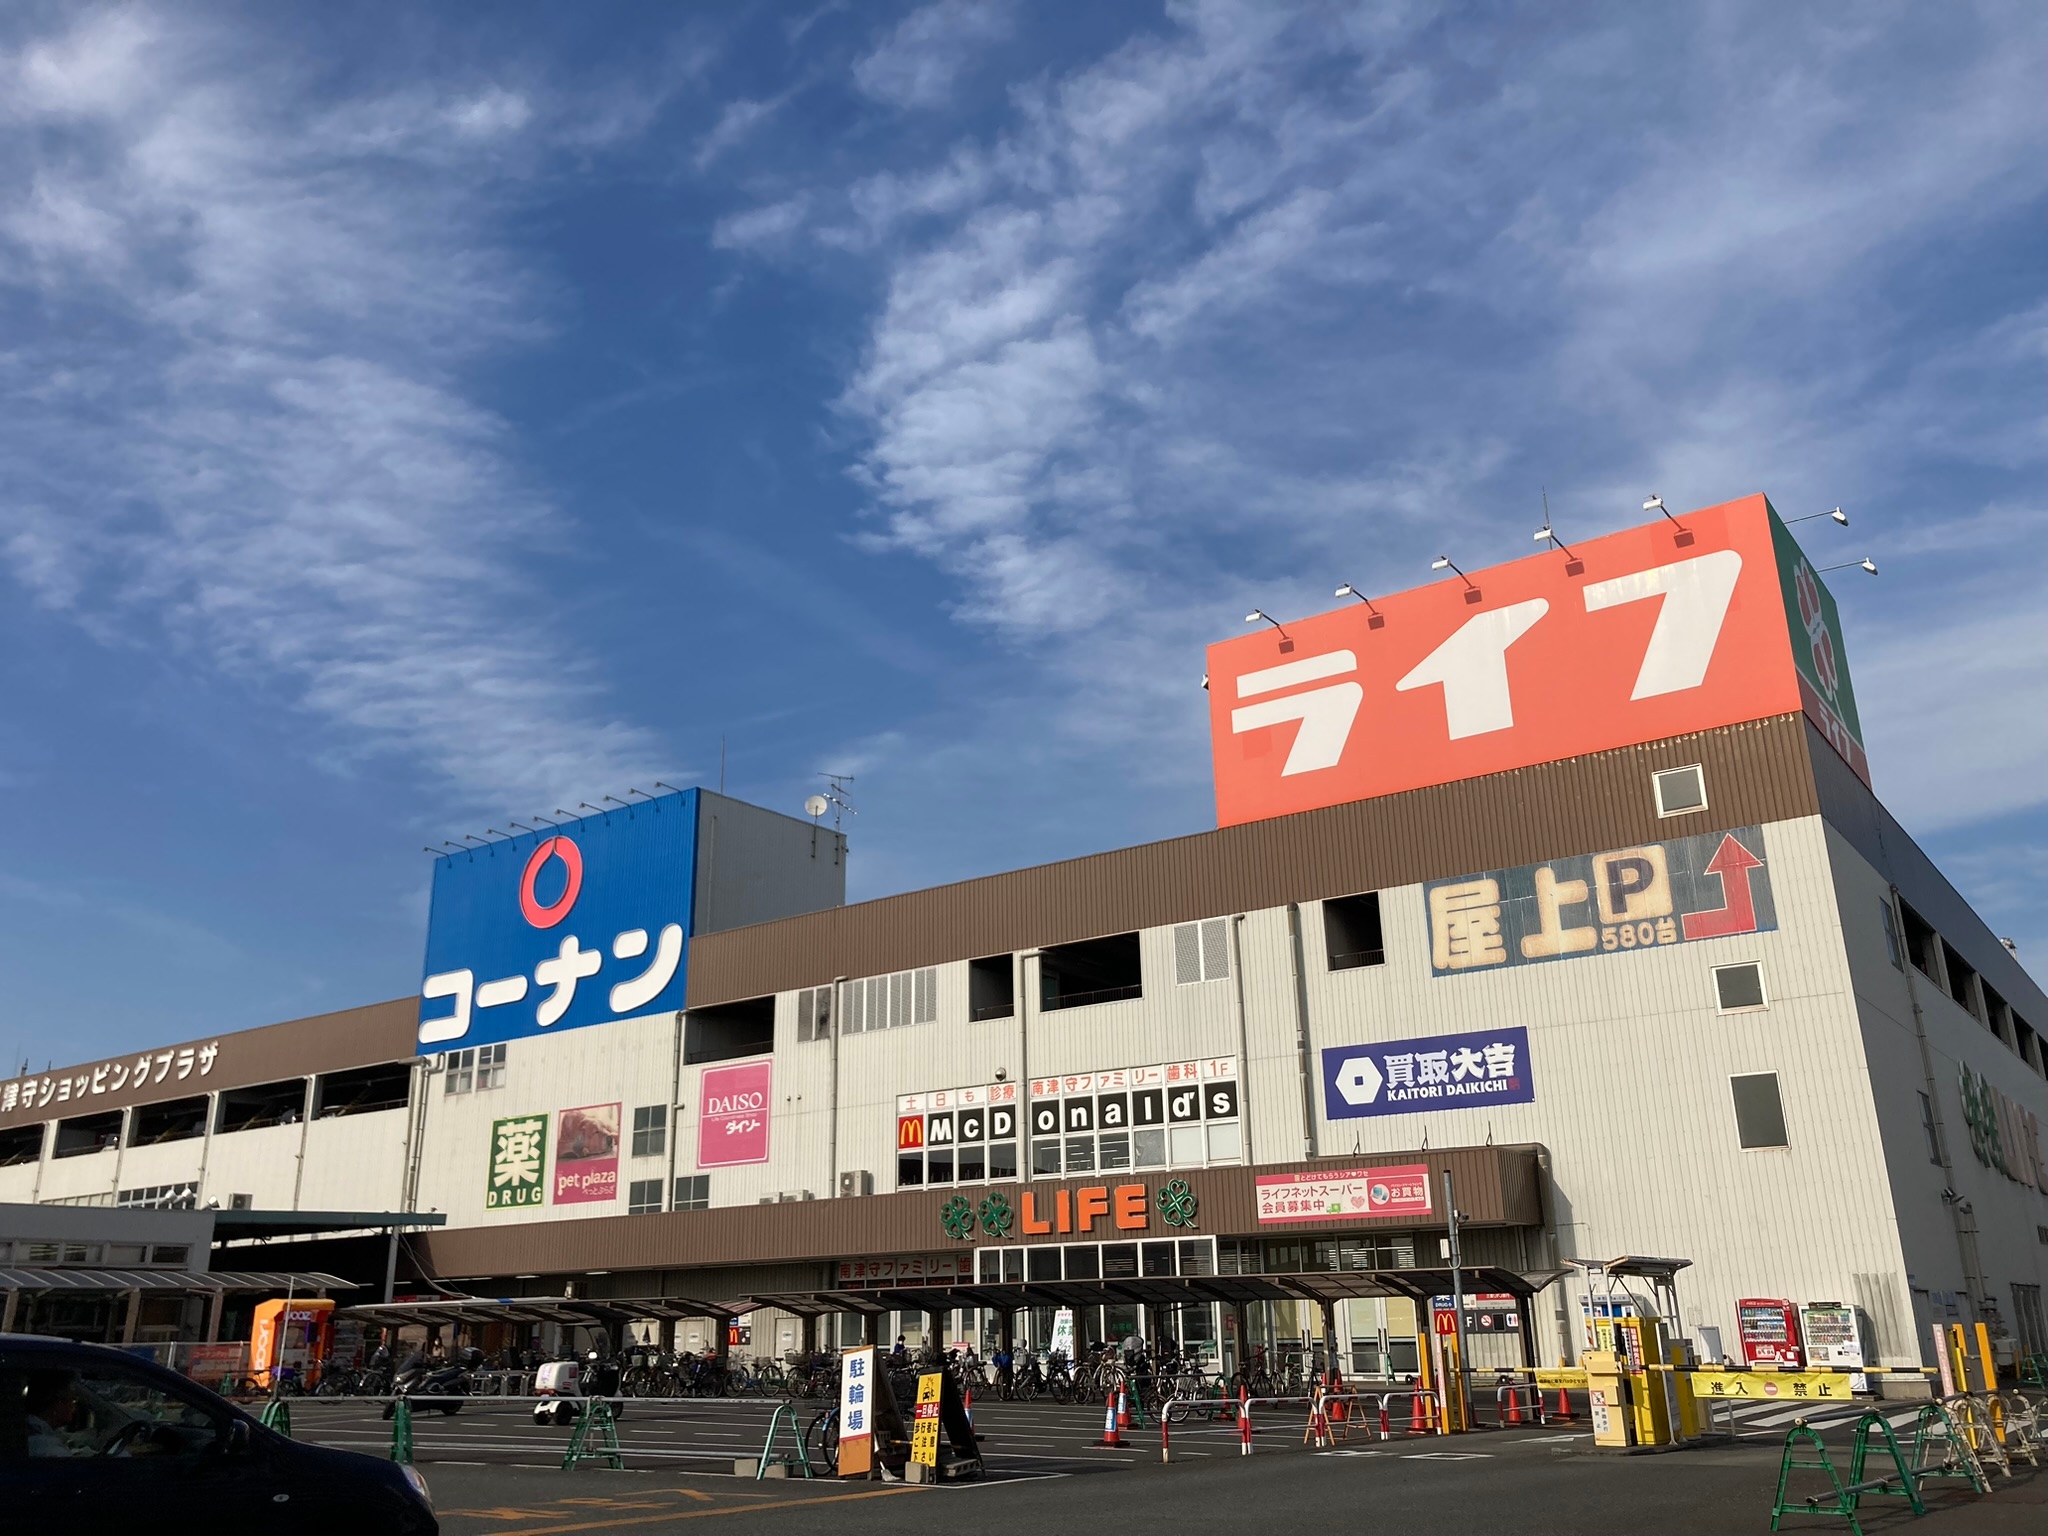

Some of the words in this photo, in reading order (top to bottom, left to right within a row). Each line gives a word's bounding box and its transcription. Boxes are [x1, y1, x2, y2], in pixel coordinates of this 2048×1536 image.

[1231, 549, 1743, 778] ライフ
[1601, 916, 1678, 951] 580台
[418, 923, 683, 1044] コーナン
[0, 1040, 220, 1112] 津守ショッピングプラザ
[1383, 1042, 1516, 1089] 買取大吉
[1031, 1062, 1199, 1096] 南津守ファミリー歯科
[1386, 1085, 1443, 1102] KAITORI
[1445, 1079, 1508, 1097] DAIKICHI
[708, 1092, 763, 1114] DAISO
[905, 1084, 1016, 1110] 土日も診療
[725, 1118, 761, 1135] ダイソー
[929, 1090, 1232, 1143] McDonald's
[493, 1119, 543, 1188] 薬
[557, 1172, 581, 1196] pet
[582, 1170, 617, 1190] plaza
[1261, 1183, 1363, 1201] ライフネットスーパー
[1390, 1186, 1424, 1199] お買物
[487, 1187, 543, 1207] DRUG
[1021, 1183, 1148, 1235] LIFE
[1262, 1199, 1325, 1215] 会員募集中
[847, 1357, 865, 1431] 駐輪場
[1711, 1382, 1749, 1396] 進入
[1793, 1382, 1833, 1397] 禁止
[916, 1404, 939, 1418] 一旦停止
